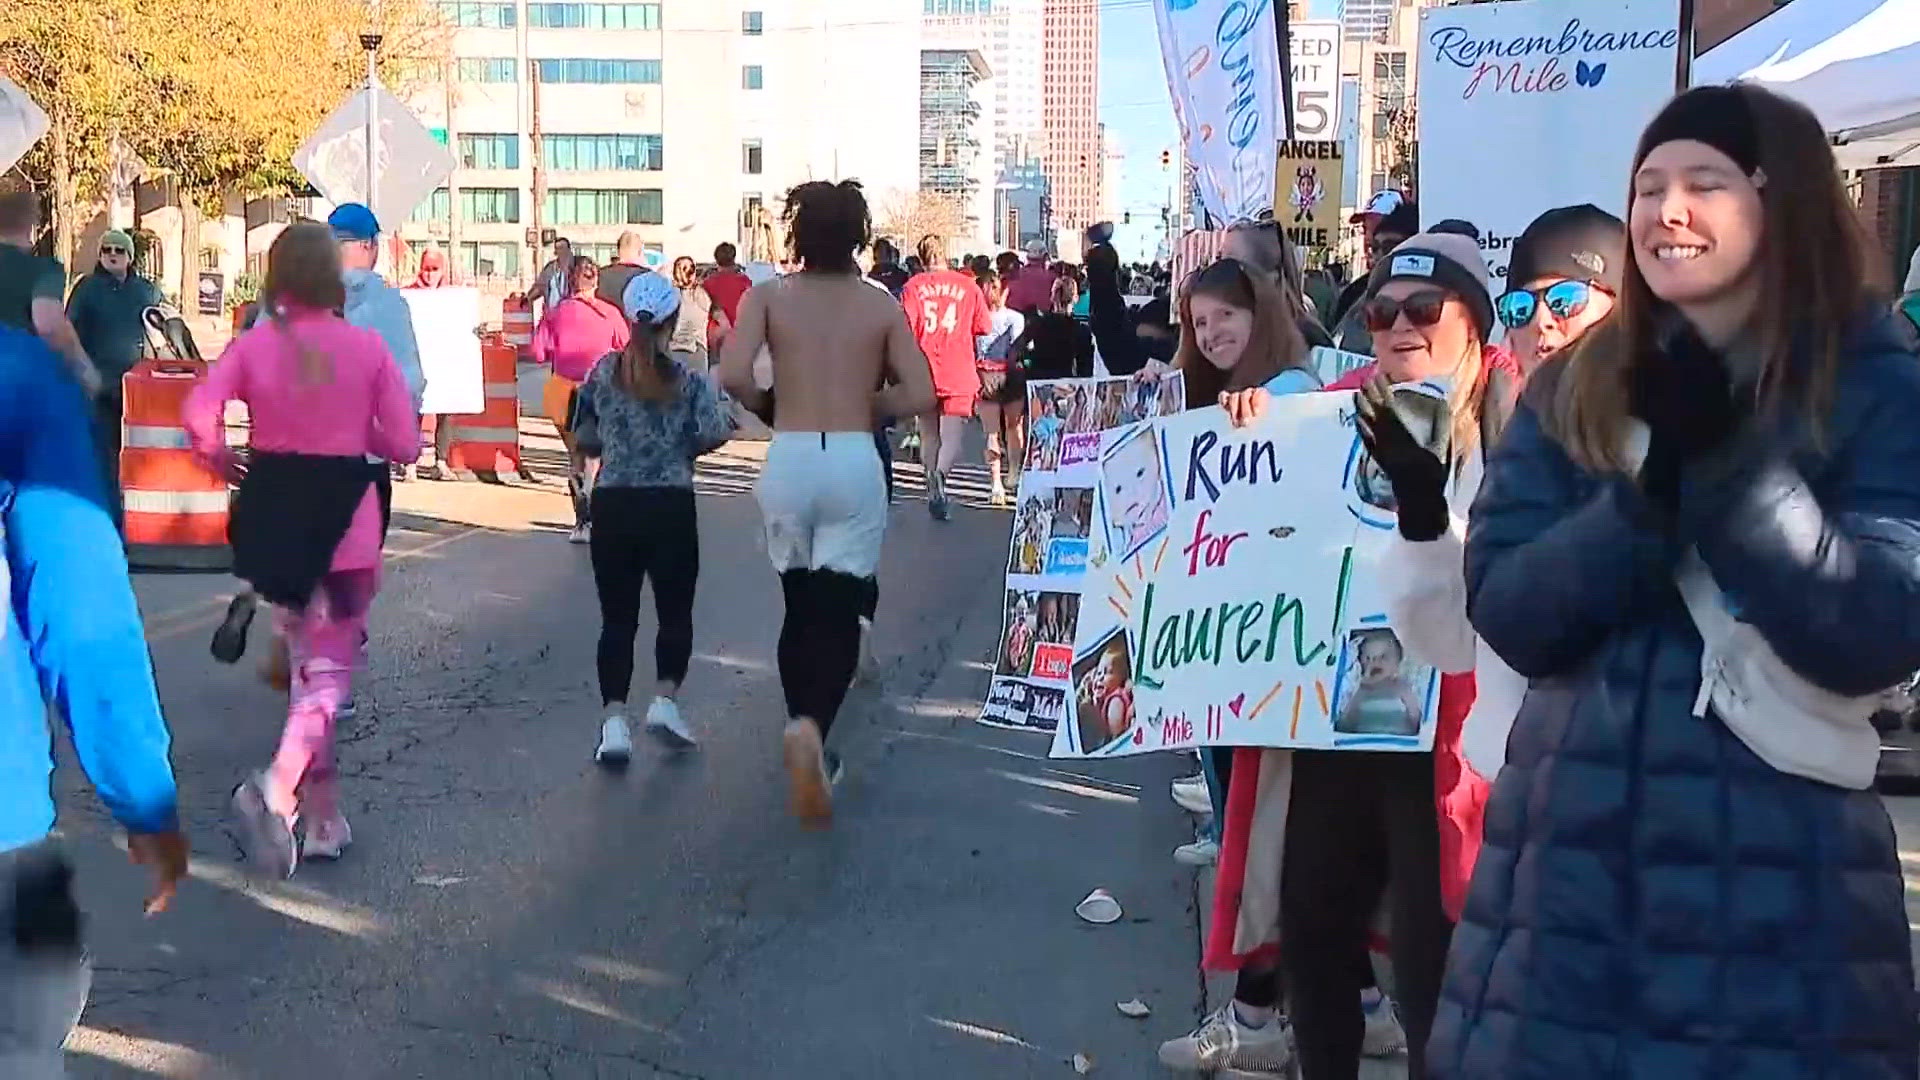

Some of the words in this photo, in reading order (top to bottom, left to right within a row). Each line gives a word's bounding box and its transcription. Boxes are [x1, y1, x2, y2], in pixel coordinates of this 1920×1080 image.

[1289, 38, 1332, 56] EED
[1430, 18, 1677, 68] Remembrance
[1463, 57, 1568, 100] Mile
[1296, 91, 1329, 134] 5
[1280, 140, 1341, 160] ANGEL
[1477, 230, 1513, 250] ebr
[923, 301, 957, 335] 54
[1184, 430, 1283, 503] Run
[1183, 509, 1249, 578] for
[1133, 546, 1354, 691] Lauren!
[1162, 711, 1194, 746] Mile
